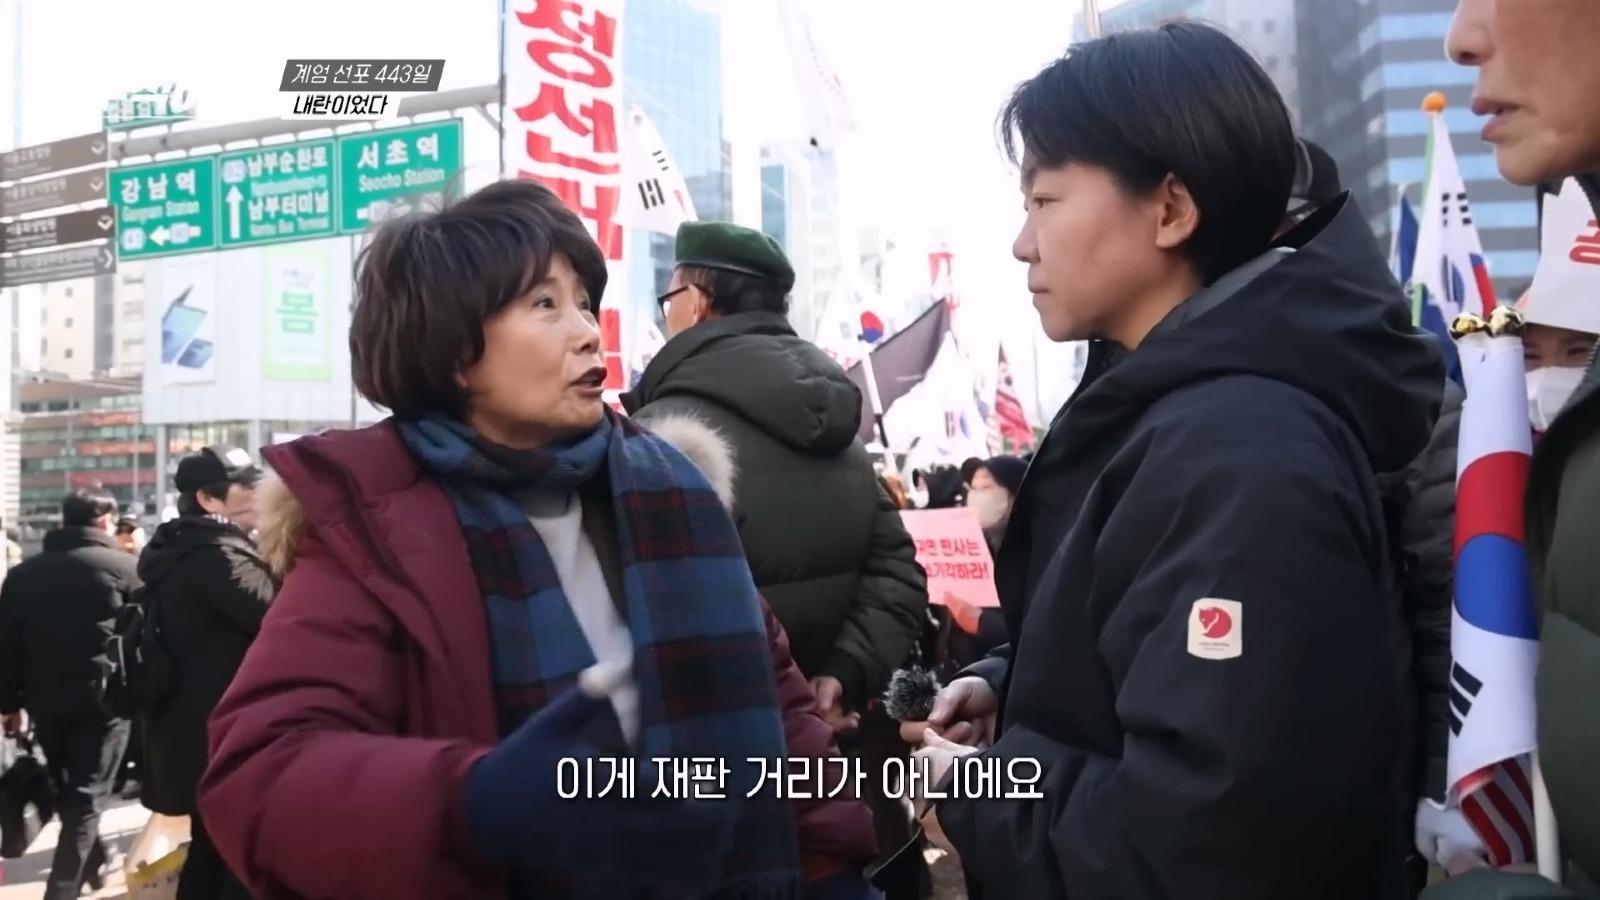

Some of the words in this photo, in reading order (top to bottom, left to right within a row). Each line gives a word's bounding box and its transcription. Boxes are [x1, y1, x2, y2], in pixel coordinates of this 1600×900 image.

[246, 146, 328, 178] 남부순환로
[248, 189, 329, 221] 남부터미널
[275, 290, 318, 335] 봄
